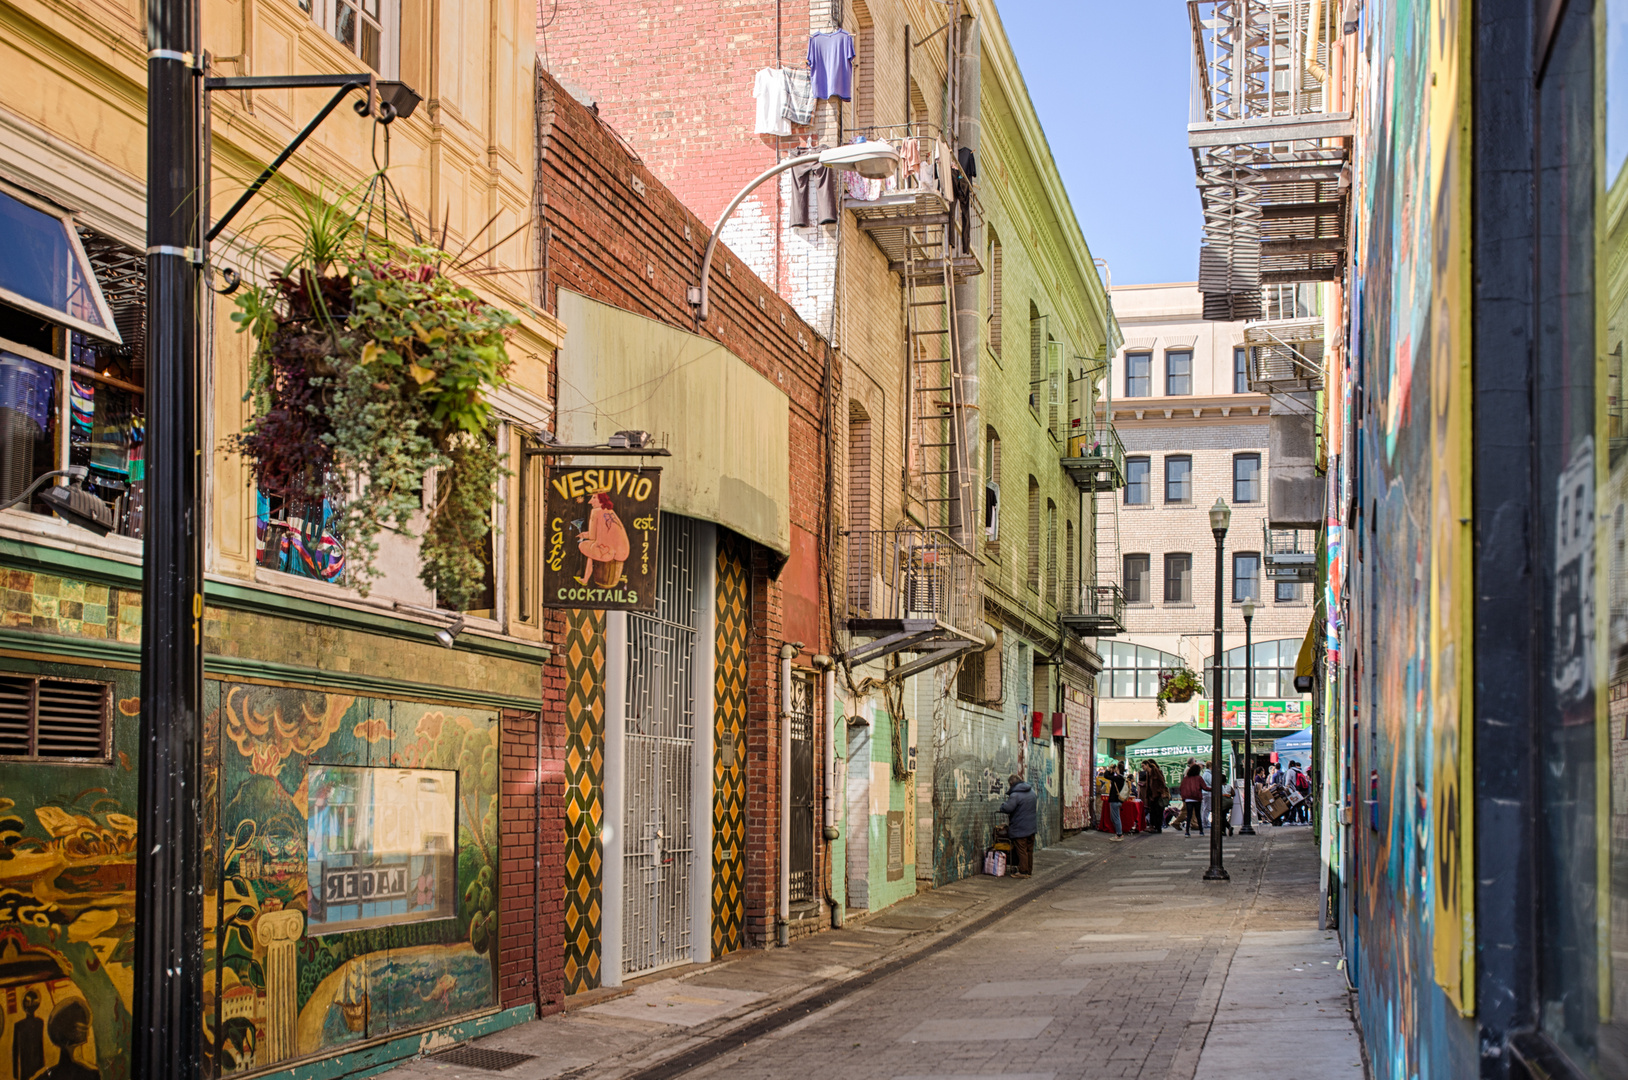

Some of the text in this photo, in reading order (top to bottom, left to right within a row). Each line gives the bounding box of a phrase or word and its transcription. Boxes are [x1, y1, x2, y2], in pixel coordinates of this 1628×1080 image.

[633, 514, 657, 531] est.
[641, 530, 649, 575] 1948
[557, 587, 638, 604] COCKTAILS
[1134, 748, 1160, 757] FREE
[1160, 746, 1195, 756] SPINAL
